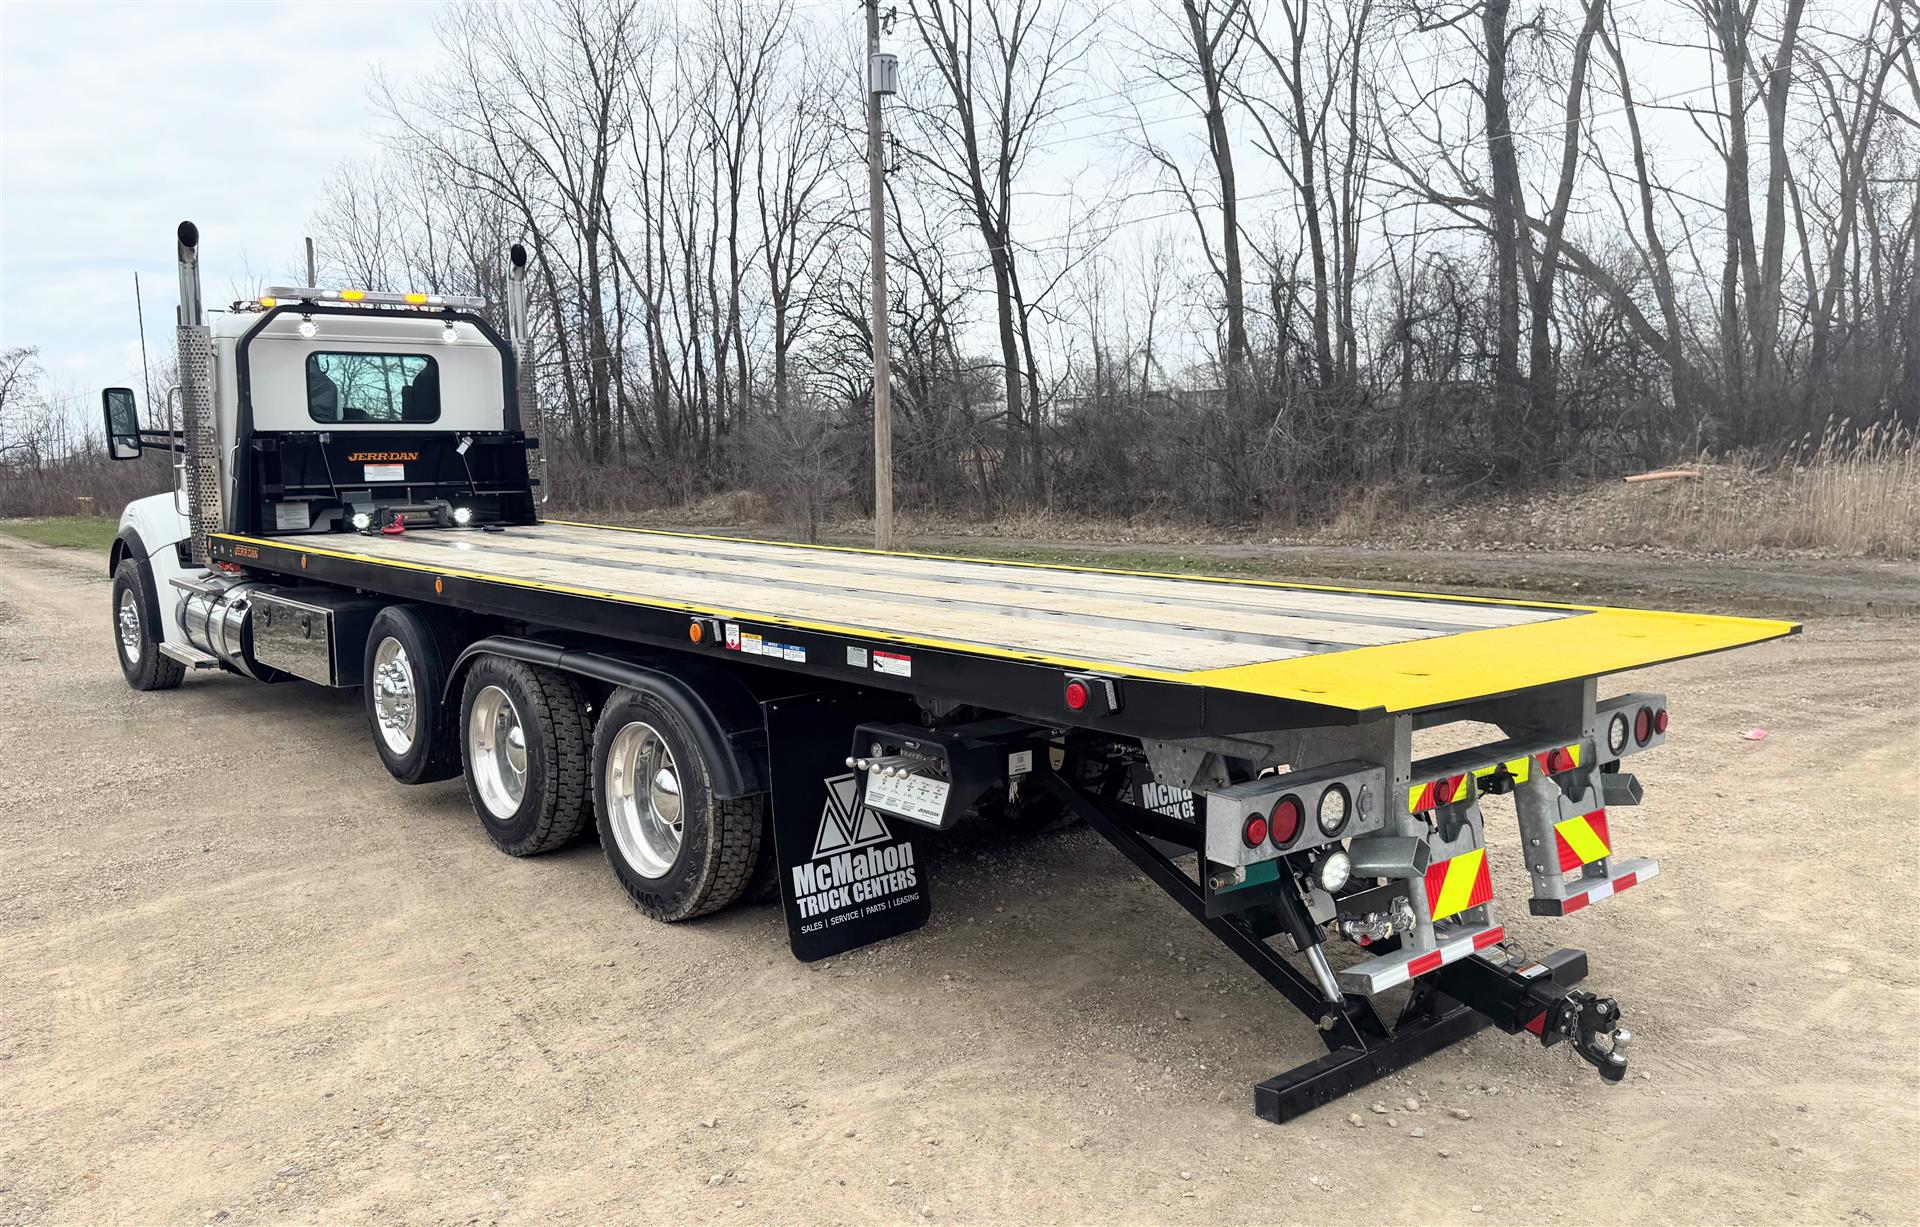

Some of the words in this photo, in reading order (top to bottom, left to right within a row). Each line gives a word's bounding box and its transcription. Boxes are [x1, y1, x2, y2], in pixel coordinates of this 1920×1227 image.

[1142, 782, 1192, 809] McMa
[792, 842, 914, 898] McMahon
[796, 885, 852, 919] TRUCK
[853, 867, 917, 903] CENTERS
[801, 921, 823, 934] SALES
[830, 910, 859, 926] SERVICE
[866, 902, 886, 915] PARTS
[893, 892, 919, 907] LEASING
